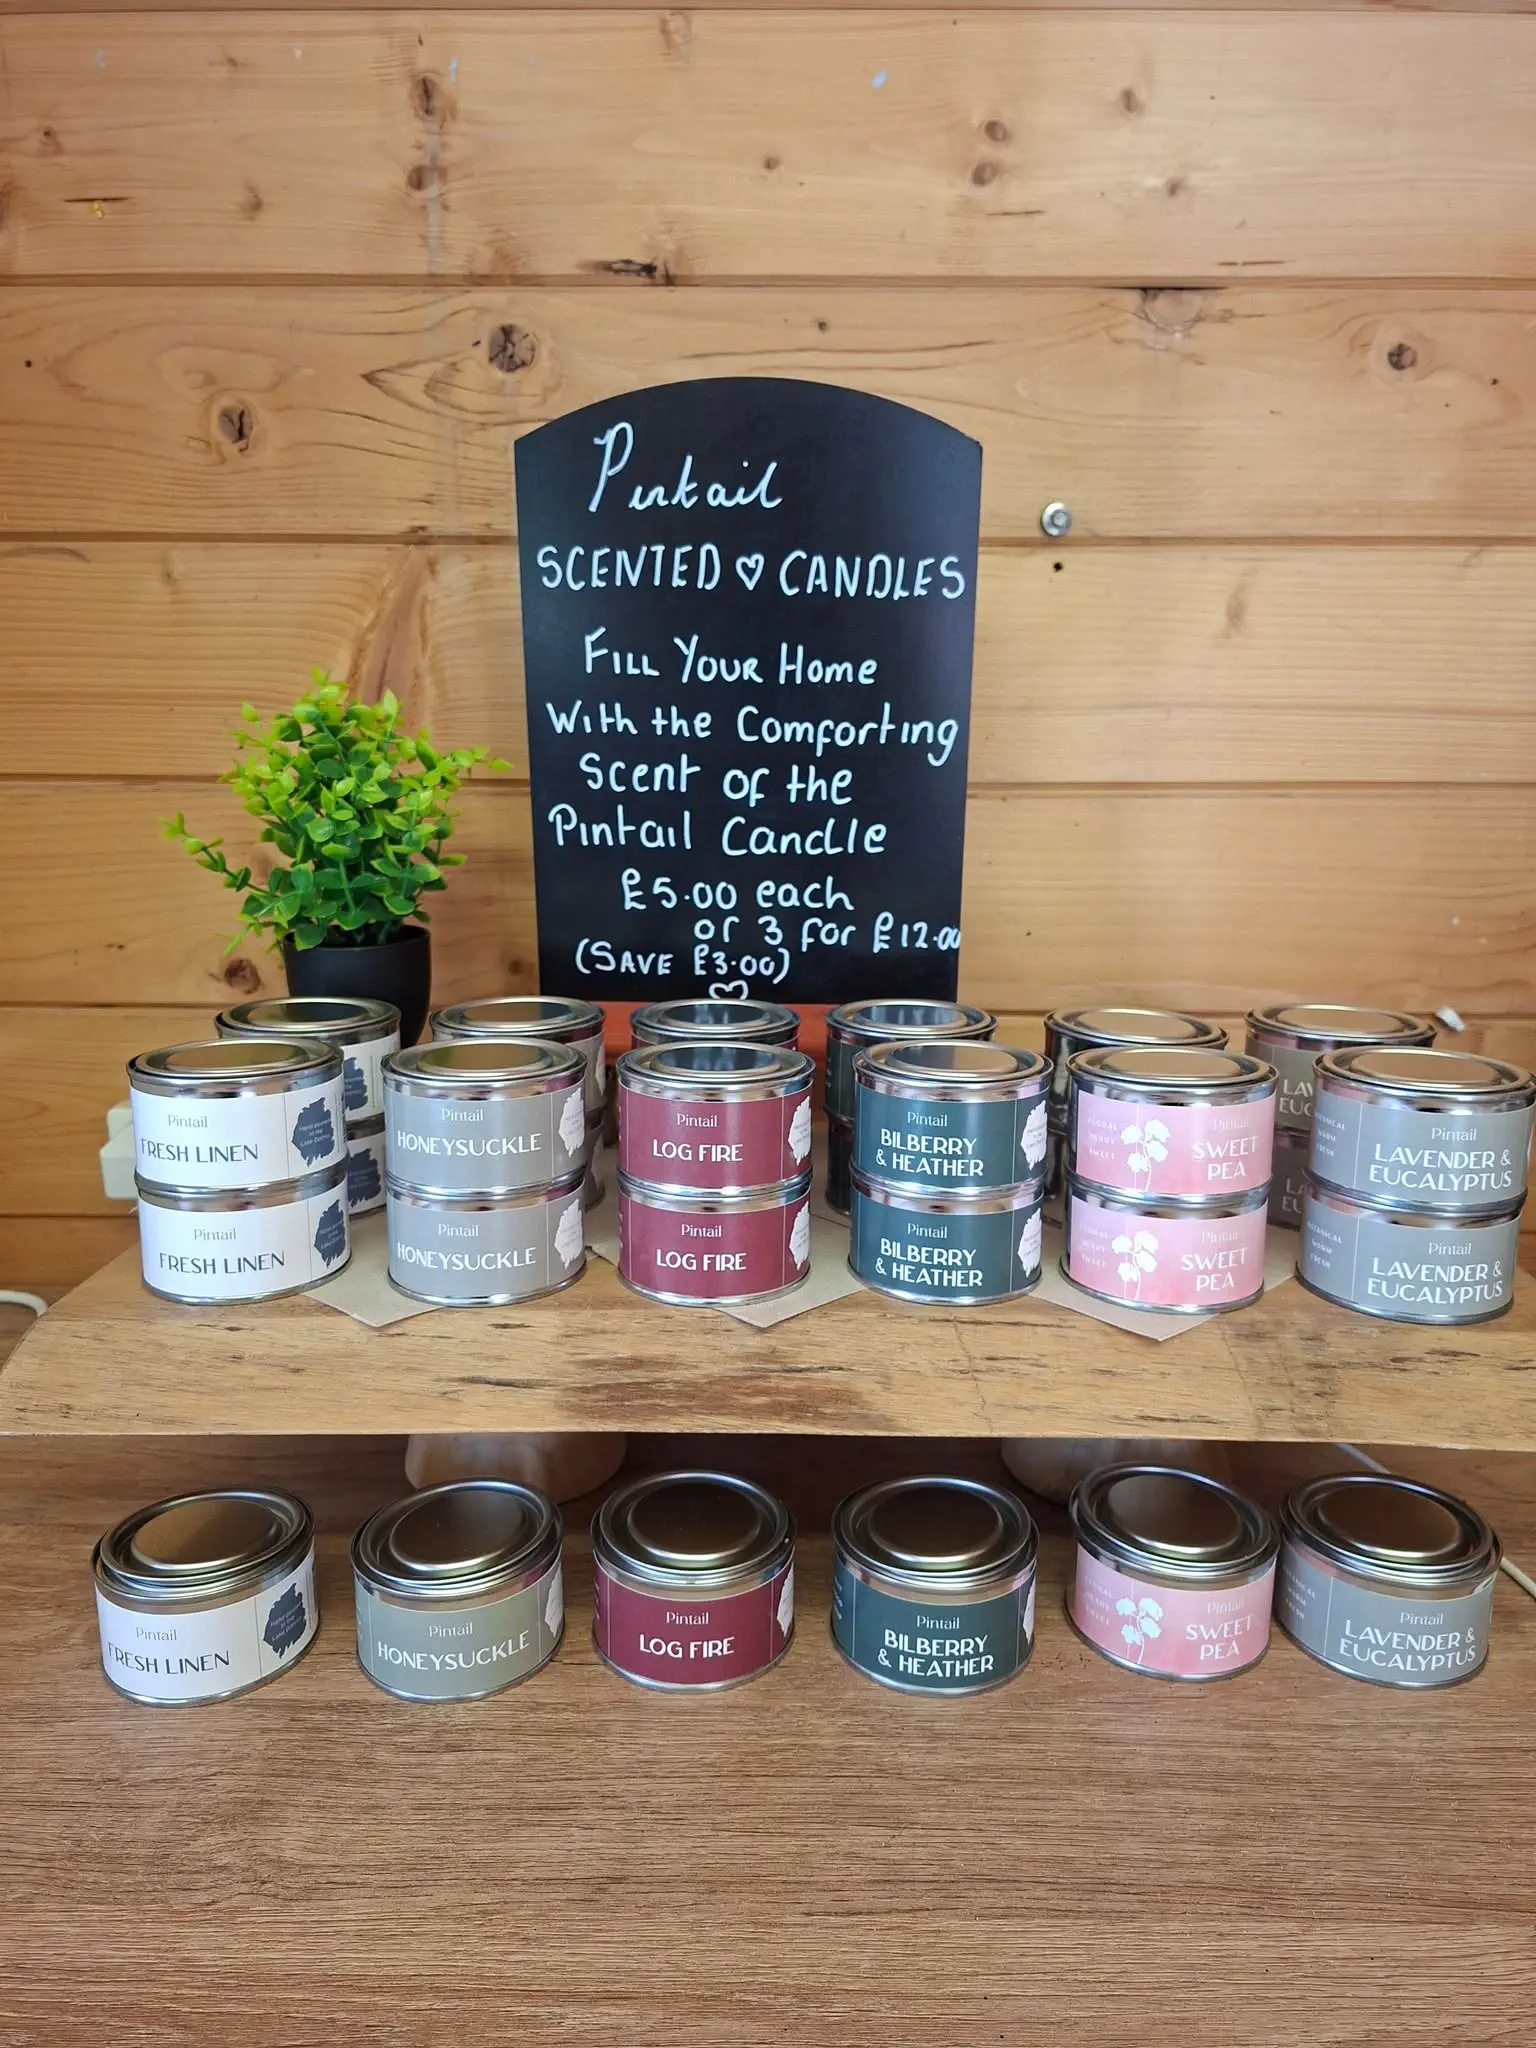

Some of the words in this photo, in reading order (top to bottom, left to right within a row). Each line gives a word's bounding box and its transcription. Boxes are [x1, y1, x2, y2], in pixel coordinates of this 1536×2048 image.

[588, 421, 783, 513] Pintail
[537, 544, 722, 591] SCENTED
[780, 549, 967, 600] CANDLES
[778, 642, 879, 686] Home
[546, 701, 638, 736] With
[653, 704, 712, 738] the
[737, 702, 959, 766] Comforting
[580, 753, 701, 793] Scent
[723, 768, 771, 808] of
[787, 765, 854, 806] the
[548, 804, 692, 851] Pintail
[722, 814, 887, 857] Candle
[622, 868, 738, 911] £5.00
[756, 876, 855, 912] each
[693, 915, 741, 943] or
[757, 915, 784, 946] 3
[800, 917, 857, 953] for
[694, 943, 790, 985] £3.00)
[168, 1114, 208, 1128] Pintail
[441, 1108, 484, 1122] Pintail
[677, 1113, 718, 1128] Pintail
[907, 1111, 948, 1127] Pintail
[397, 1130, 542, 1157] HONEYSUCKLE
[881, 1128, 977, 1156] BILBERRY
[1431, 1127, 1477, 1141] Pintail
[141, 1138, 188, 1163] FRESH
[196, 1143, 259, 1163] LINEN
[653, 1139, 692, 1161] LOG
[698, 1144, 744, 1162] FIRE
[1192, 1136, 1259, 1160] SWEET
[1374, 1143, 1496, 1169] LAVENDER
[1500, 1149, 1512, 1166] &
[875, 1149, 887, 1167] &
[892, 1155, 984, 1177] HEATHER
[1207, 1161, 1246, 1181] PEA
[1369, 1164, 1512, 1191] EUCALYPTUS
[194, 1228, 236, 1241] Pintail
[438, 1223, 479, 1237] Pintail
[681, 1223, 722, 1237] Pintail
[907, 1223, 948, 1239] Pintail
[397, 1242, 537, 1271] HONEYSUCKLE
[656, 1249, 697, 1271] LOG
[703, 1252, 747, 1271] FIRE
[880, 1238, 977, 1267] BILBERRY
[1180, 1247, 1249, 1271] SWEET
[1428, 1242, 1471, 1255] Pintail
[159, 1252, 216, 1274] FRESH
[224, 1250, 285, 1274] LINEN
[875, 1257, 887, 1276] &
[892, 1262, 983, 1287] HEATHER
[1373, 1257, 1488, 1282] LAVENDER
[1492, 1260, 1502, 1277] &
[1195, 1272, 1234, 1292] PEA
[1367, 1278, 1503, 1304] EUCALYPTUS
[429, 1622, 473, 1637] Pintail
[666, 1611, 709, 1625] Pintail
[916, 1615, 960, 1630] Pintail
[1185, 1614, 1254, 1641] SWEET
[1399, 1611, 1443, 1626] Pintail
[136, 1626, 177, 1641] Pintail
[885, 1629, 988, 1657] BILBERRY
[1345, 1619, 1460, 1651] LAVENDER
[1465, 1627, 1475, 1643] &
[108, 1641, 158, 1674] FRESH
[166, 1650, 230, 1674] LINEN
[377, 1629, 530, 1671] HONEYSUCKLE
[639, 1634, 683, 1659] LOG
[689, 1636, 735, 1659] FIRE
[1200, 1640, 1240, 1661] PEA
[1340, 1637, 1476, 1671] EUCALYPTUS
[877, 1648, 892, 1668] &
[899, 1655, 994, 1678] HEATHER
